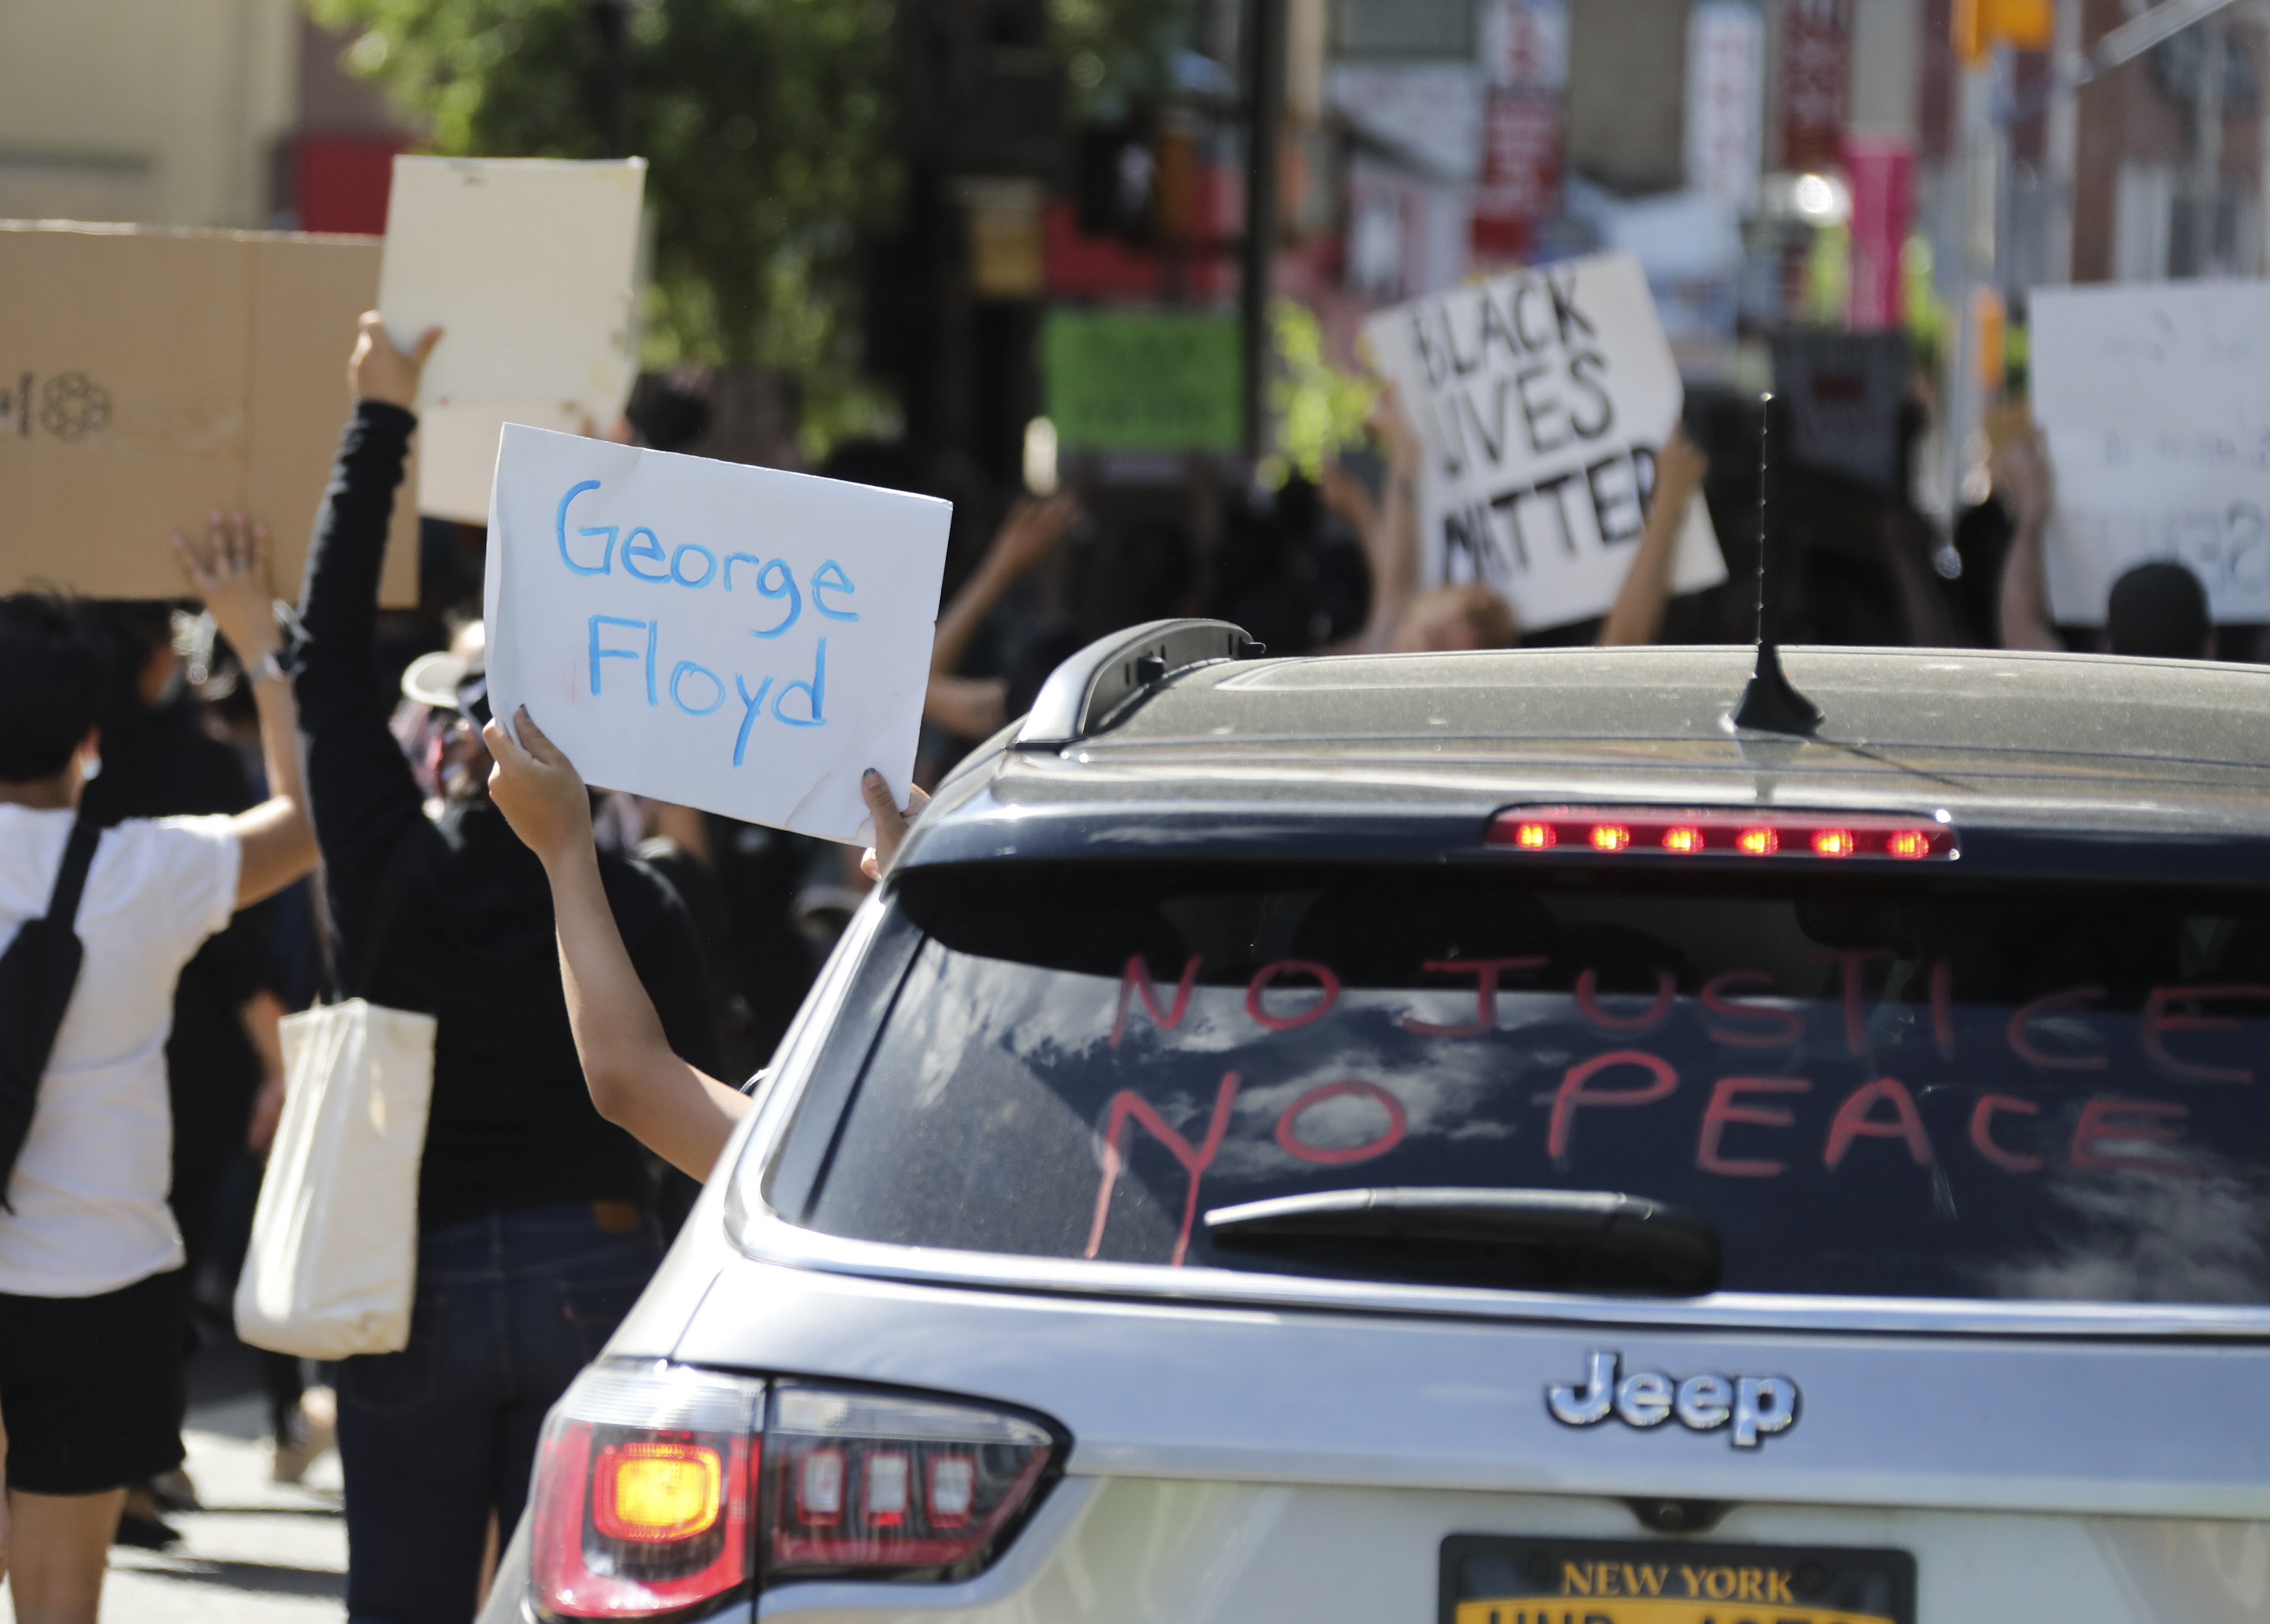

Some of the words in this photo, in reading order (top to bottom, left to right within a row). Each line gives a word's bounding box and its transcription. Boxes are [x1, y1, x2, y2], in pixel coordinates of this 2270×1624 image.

[1411, 269, 1596, 389] BLACK
[556, 479, 860, 640] George
[588, 614, 827, 768] Floyd
[1110, 954, 1340, 1047] NO
[1400, 949, 2270, 1085] JUSTICE
[1083, 1070, 1407, 1267] NO
[1547, 1050, 2205, 1176] PEACE
[1546, 1351, 1802, 1451] Jeep
[1563, 1561, 1669, 1598] NEW
[1679, 1564, 1795, 1604] YORK
